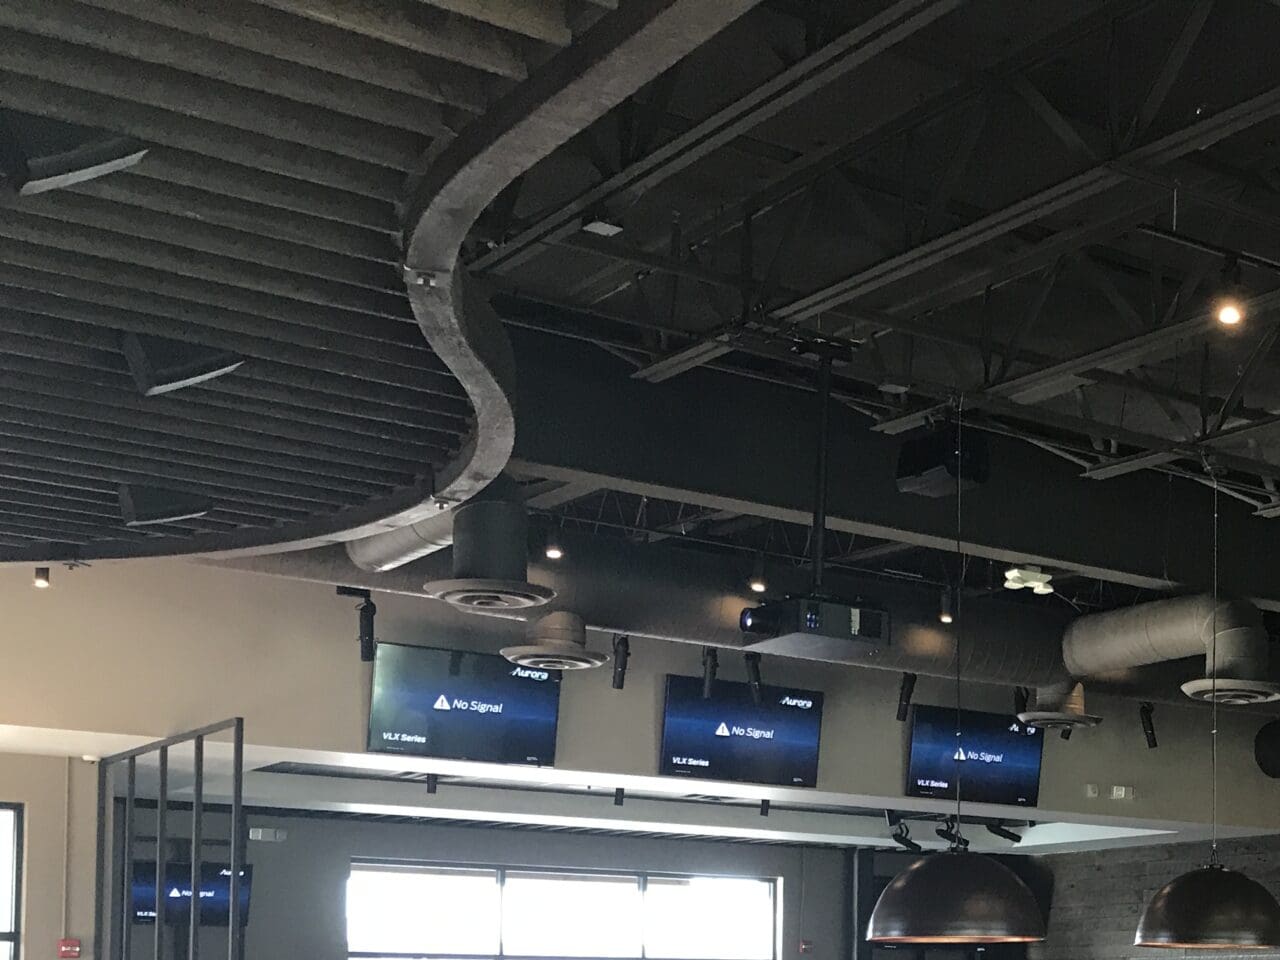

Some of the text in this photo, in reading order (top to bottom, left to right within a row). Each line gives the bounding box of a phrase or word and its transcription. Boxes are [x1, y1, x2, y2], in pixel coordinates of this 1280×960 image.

[511, 667, 549, 681] Aurora
[452, 699, 503, 713] No Signal
[780, 696, 813, 709] Aurora
[382, 732, 426, 743] VLX Series
[731, 726, 774, 739] No Signal
[672, 756, 709, 767] VLX Series
[967, 751, 1004, 762] No Signal
[930, 780, 949, 788] Series
